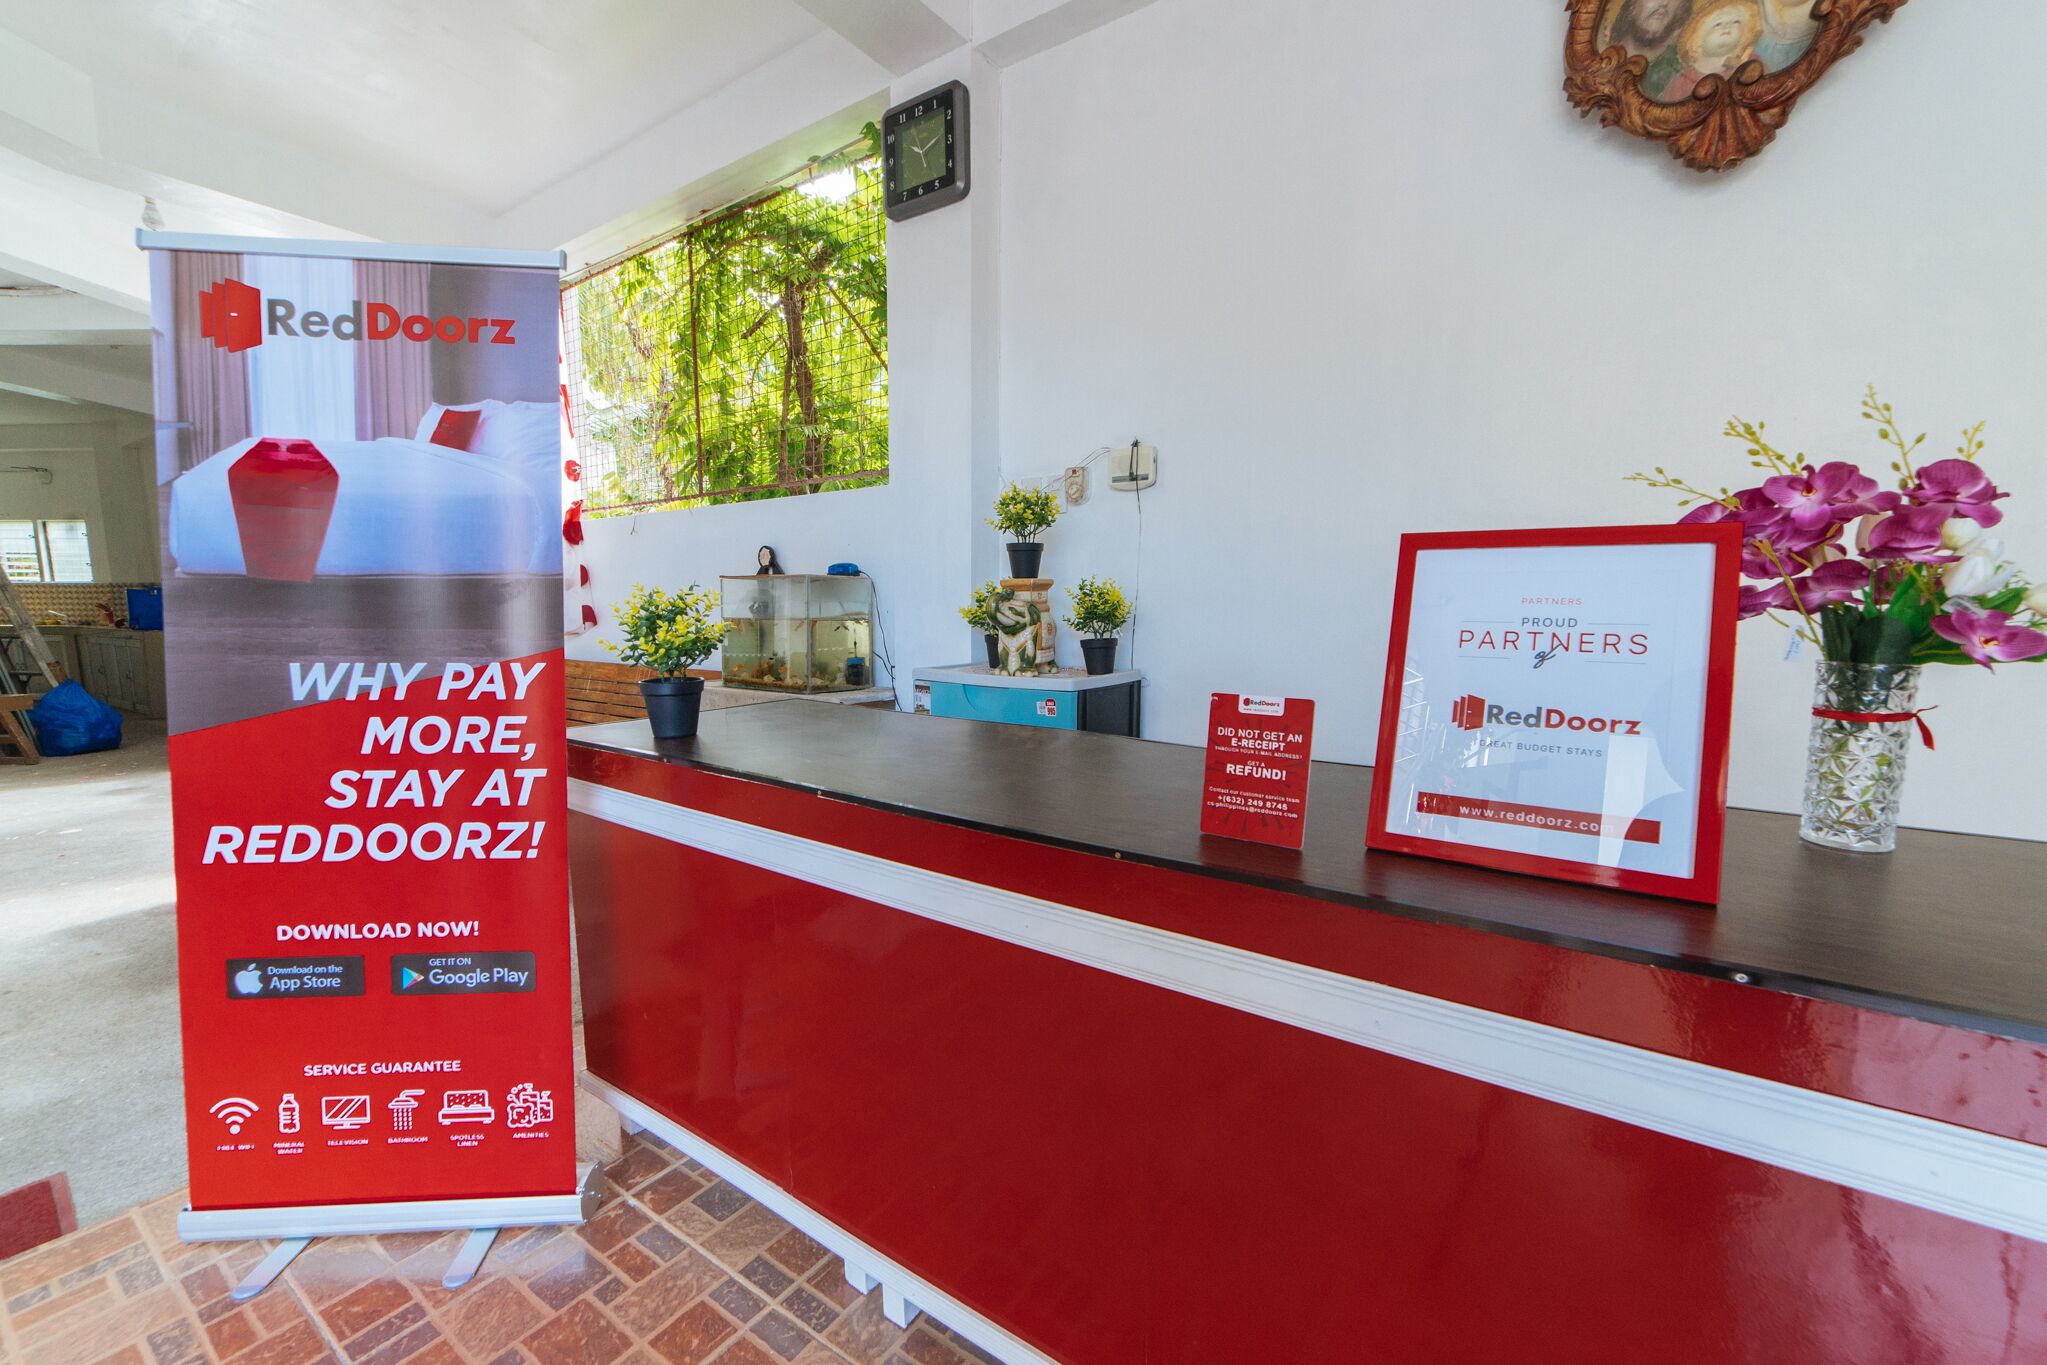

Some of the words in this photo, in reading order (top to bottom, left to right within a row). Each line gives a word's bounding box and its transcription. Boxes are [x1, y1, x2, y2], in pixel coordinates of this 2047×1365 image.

[914, 105, 923, 117] 12
[946, 109, 952, 120] 2
[899, 113, 906, 123] 11
[887, 134, 895, 145] 10
[946, 134, 952, 144] 3
[889, 157, 894, 167] 9
[947, 160, 953, 168] 4
[889, 181, 895, 190] 8
[918, 185, 924, 195] 6
[934, 180, 940, 189] 5
[902, 192, 908, 201] 7
[266, 298, 516, 345] RedDoorz
[1521, 597, 1583, 606] PARTNERS
[1521, 617, 1579, 628] PROUD
[1458, 630, 1649, 655] PARTNERS
[1533, 643, 1562, 669] of
[288, 662, 427, 702] WHY
[437, 662, 547, 701] PAY
[1486, 704, 1642, 735] RedDoorz
[360, 714, 537, 762] MORE,
[1217, 727, 1235, 736] DID
[1238, 729, 1260, 738] NOT
[1262, 731, 1285, 741] GET
[1287, 734, 1303, 743] AN
[1231, 737, 1286, 751] E-RECEIPT
[1479, 738, 1513, 749] GREAT
[1516, 742, 1562, 754] BUDGET
[1566, 746, 1603, 758] STAYS
[1226, 763, 1287, 781] REFUND!
[324, 769, 465, 809] STAY
[471, 768, 548, 806] AT
[1217, 795, 1245, 805] +(632)
[1247, 799, 1263, 807] 249
[202, 821, 546, 865] REDDOORZ!
[276, 922, 412, 941] DOWNLOAD
[417, 920, 480, 937] NOW!
[429, 958, 447, 966] GET
[447, 958, 455, 966] IT
[456, 957, 471, 965] ON
[267, 965, 313, 976] Download
[314, 966, 326, 974] on
[327, 964, 343, 973] the
[269, 976, 300, 992] App
[303, 975, 341, 988] Store
[429, 968, 490, 988] Google
[493, 967, 529, 987] Play
[303, 1063, 367, 1077] SERVICE
[370, 1060, 462, 1074] GUARANTEE
[387, 1136, 429, 1144] BATHROOM
[449, 1133, 485, 1141] SPOTLESS
